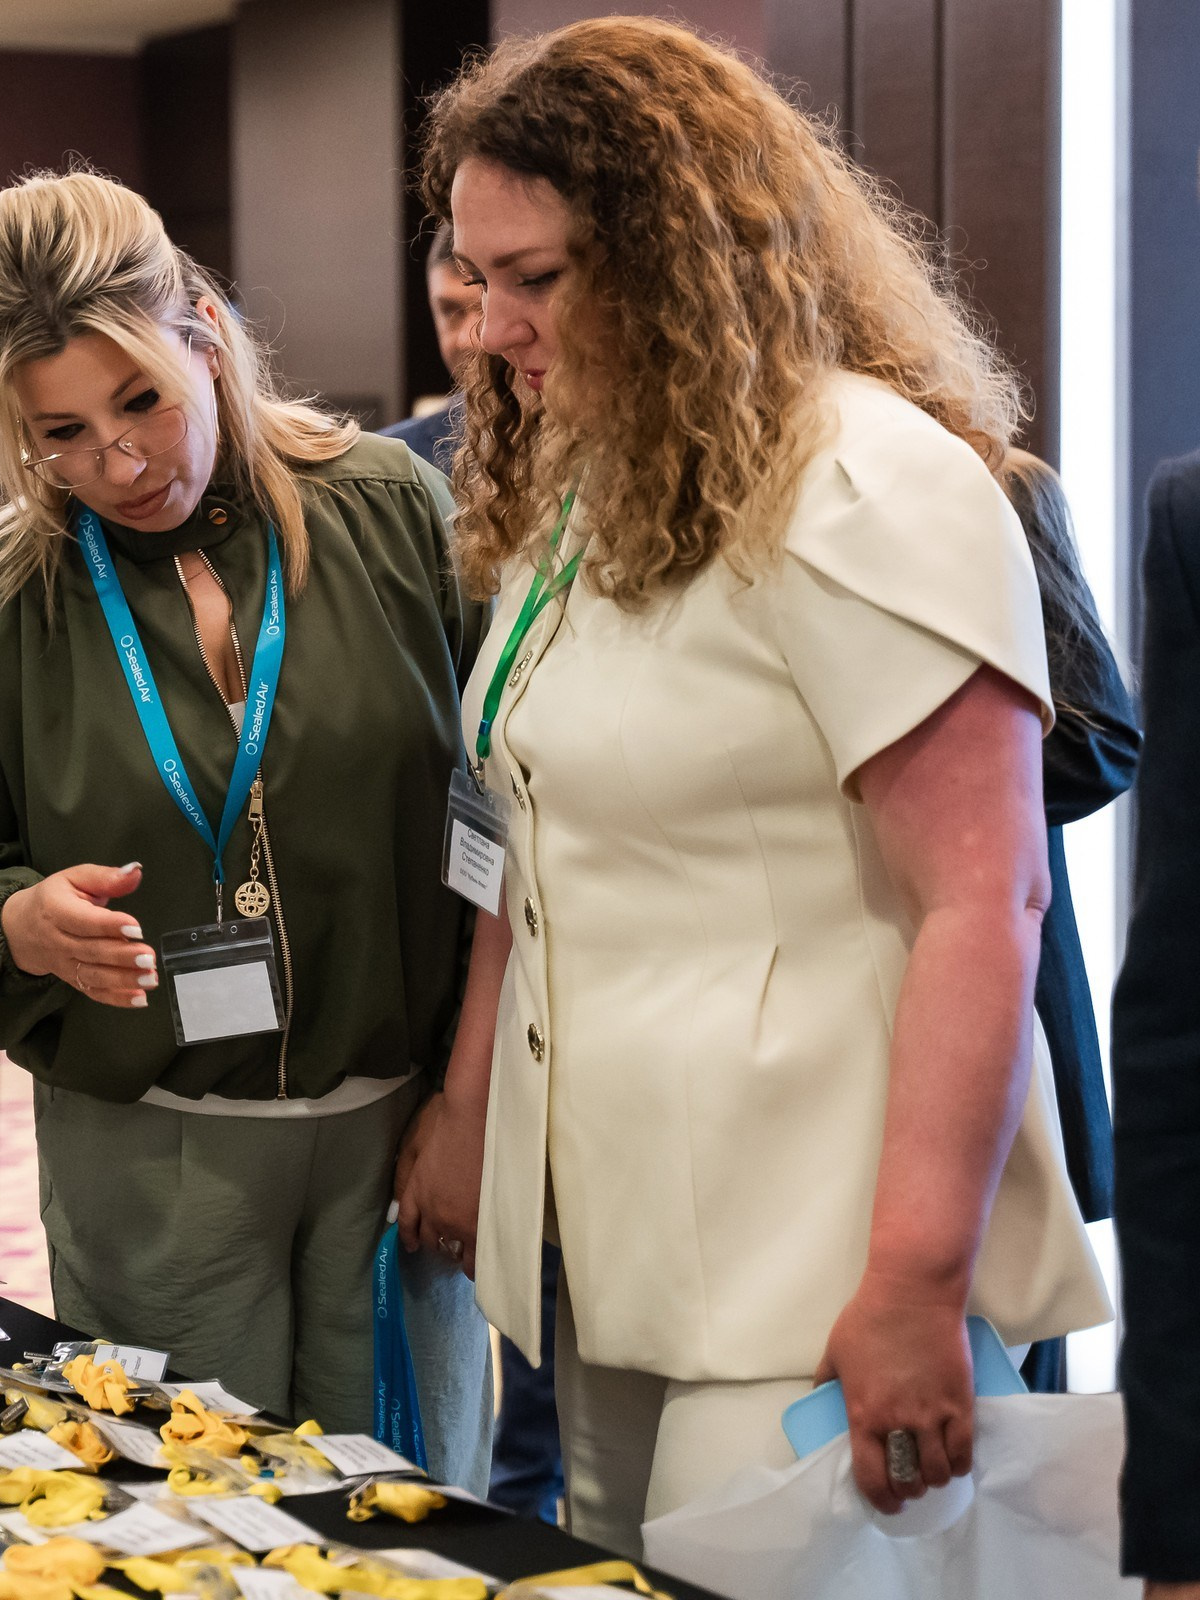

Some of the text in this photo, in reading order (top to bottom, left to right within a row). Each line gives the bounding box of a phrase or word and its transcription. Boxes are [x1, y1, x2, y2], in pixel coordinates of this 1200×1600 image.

[83, 525, 108, 579] Sealed Air
[269, 584, 279, 626] Sealed
[125, 647, 151, 703] Sealed Air
[248, 681, 269, 742] Sealed Air
[168, 771, 204, 826] Sealed Air
[378, 1246, 388, 1305] Sealed Air
[391, 1412, 403, 1453] Sealed
